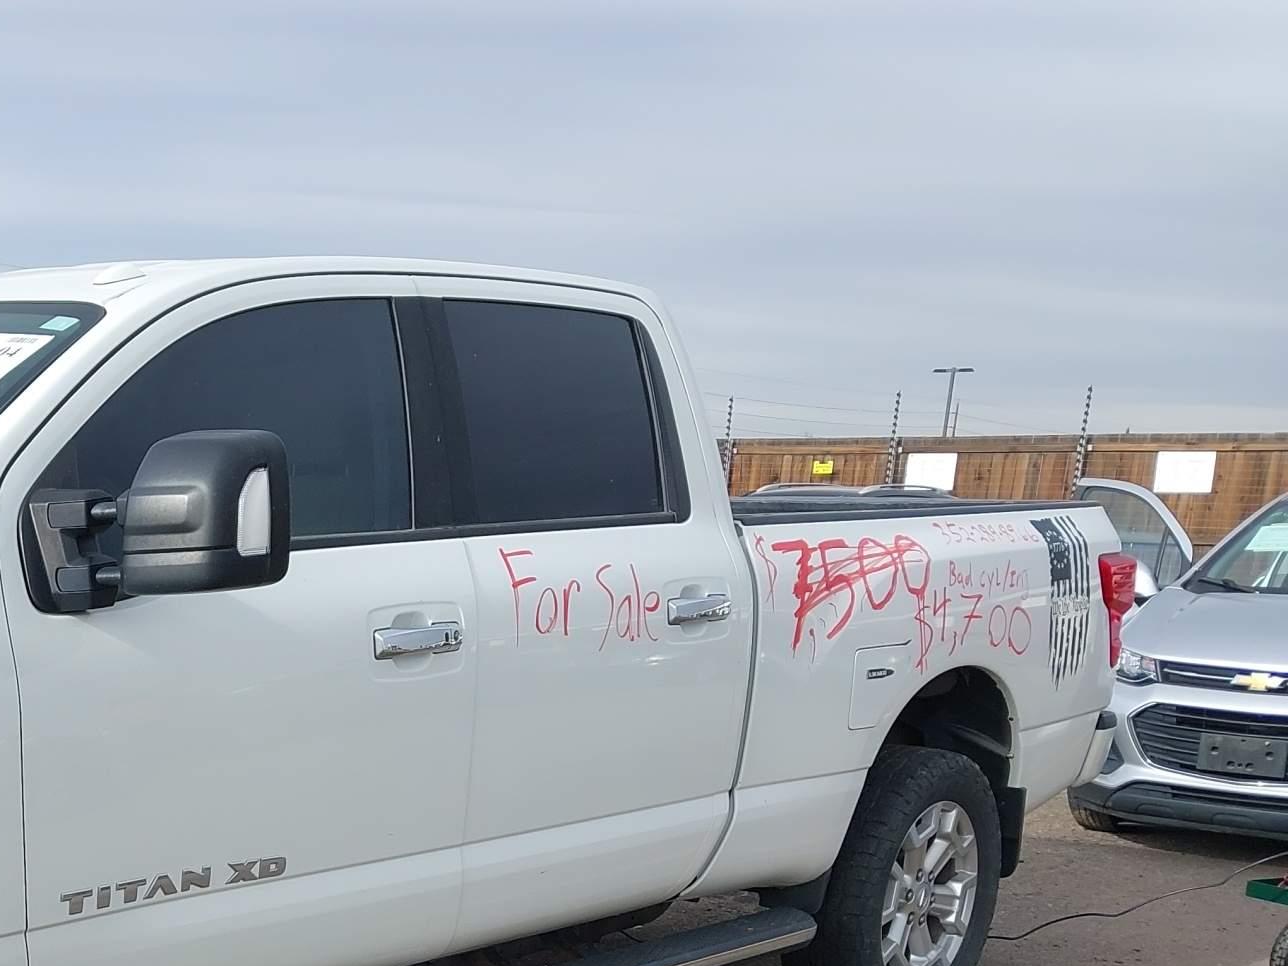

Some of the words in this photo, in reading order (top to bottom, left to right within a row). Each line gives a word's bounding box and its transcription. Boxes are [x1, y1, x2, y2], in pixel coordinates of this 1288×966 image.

[498, 548, 581, 648] For
[596, 564, 660, 652] Sale
[949, 560, 973, 588] Bad
[915, 587, 1032, 675] $4,700
[60, 865, 212, 916] TITAN
[225, 856, 287, 885] XD
